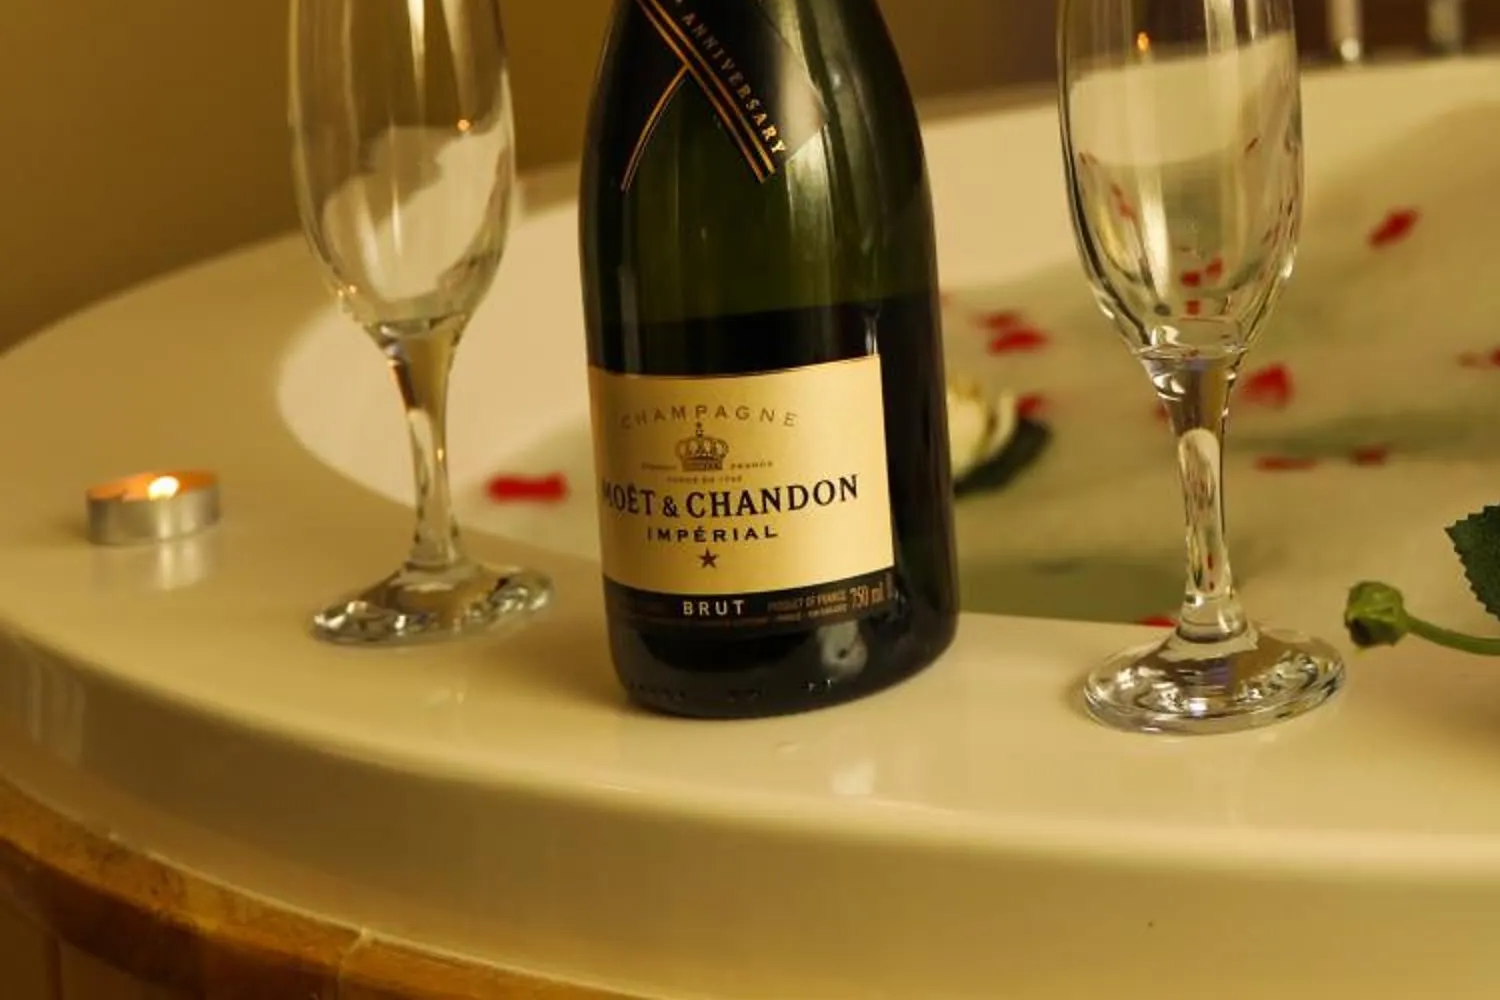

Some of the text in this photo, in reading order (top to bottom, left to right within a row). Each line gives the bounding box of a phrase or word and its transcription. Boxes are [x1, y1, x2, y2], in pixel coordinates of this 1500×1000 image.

[681, 11, 786, 153] ANNIVERSARY
[620, 404, 799, 429] CHAMPAGNE
[662, 495, 680, 518] &
[686, 473, 859, 519] CHANDON
[647, 524, 779, 543] IMPÉRIAL
[682, 600, 746, 617] BRUT
